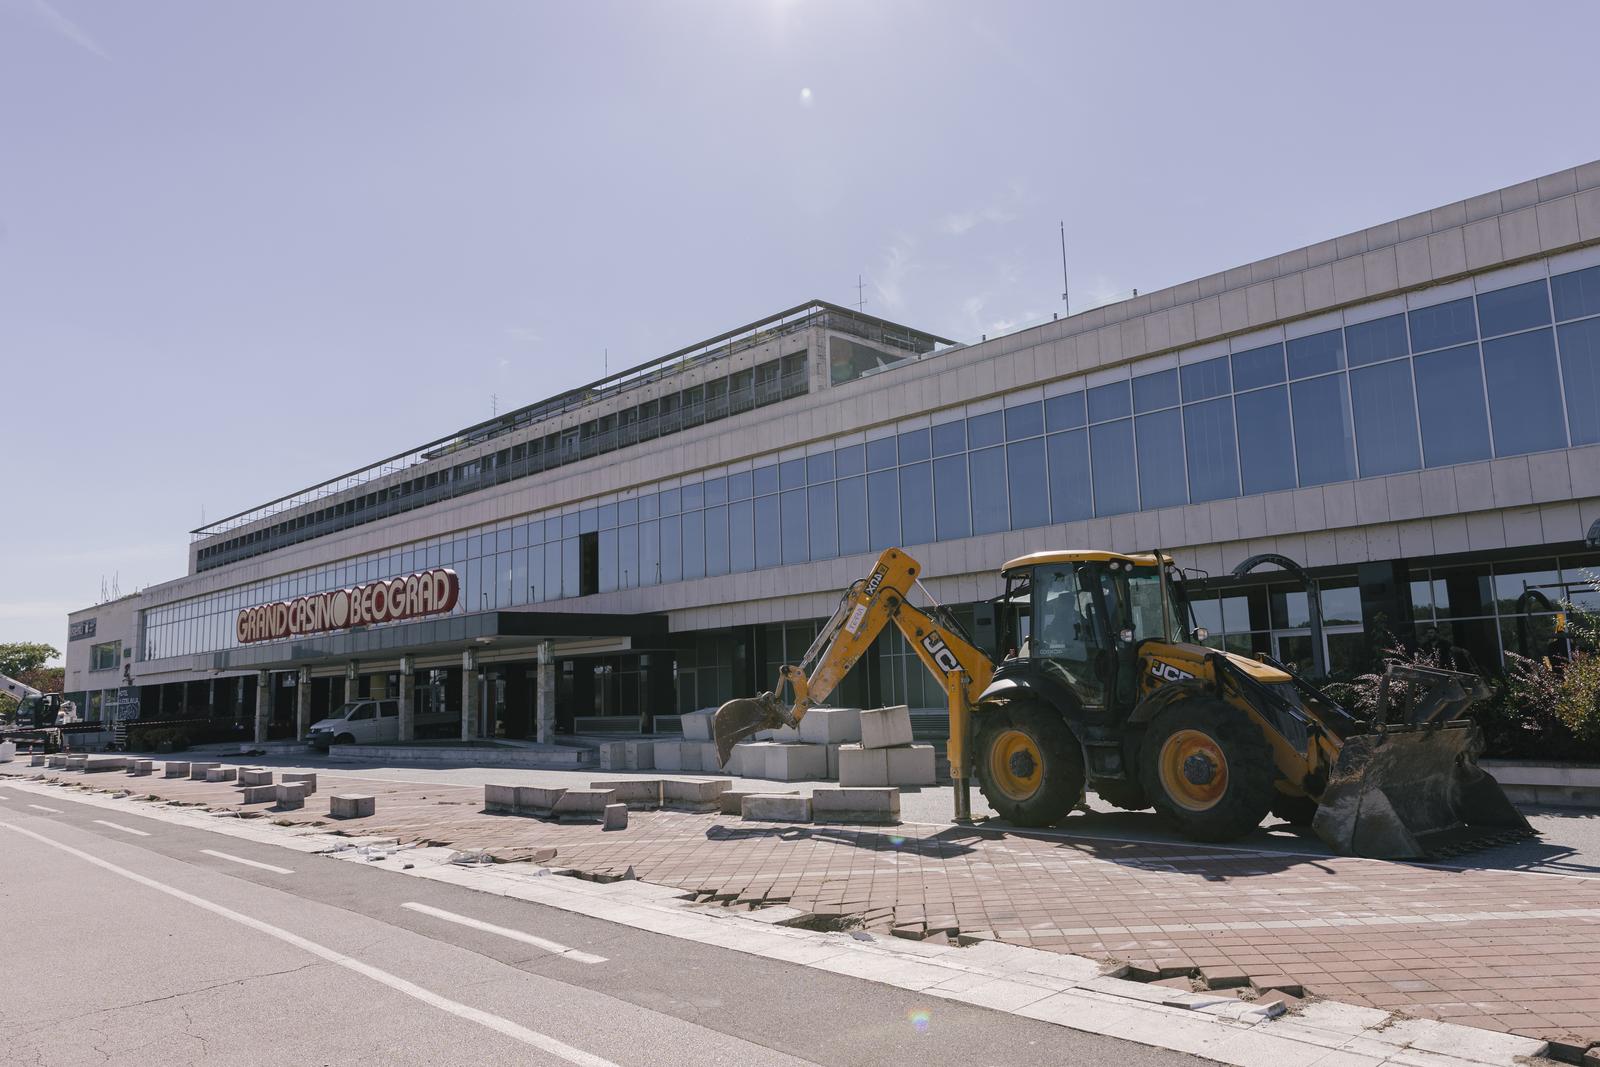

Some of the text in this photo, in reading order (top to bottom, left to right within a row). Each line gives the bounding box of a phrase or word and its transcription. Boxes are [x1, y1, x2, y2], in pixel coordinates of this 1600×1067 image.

[238, 570, 448, 642] GRAND CASINO BEOGRAD
[923, 636, 964, 675] JC
